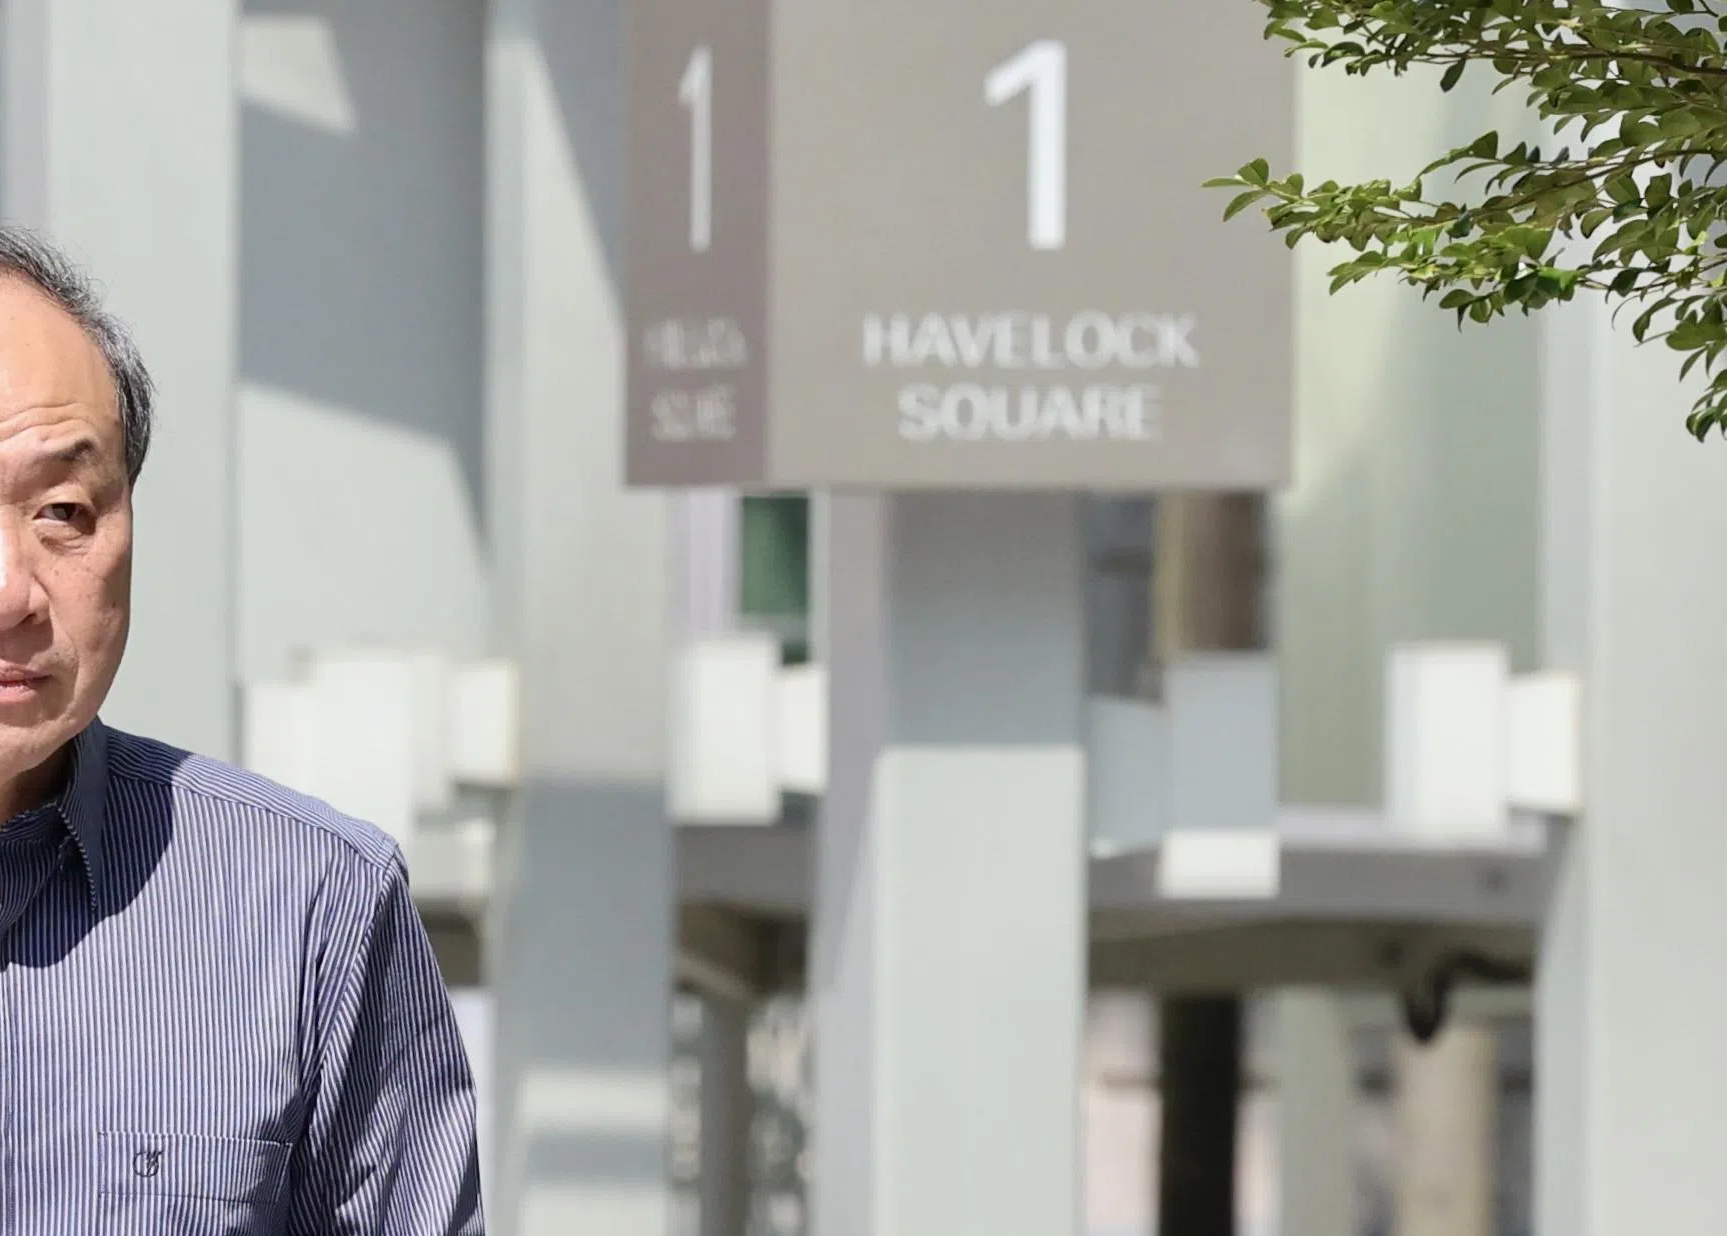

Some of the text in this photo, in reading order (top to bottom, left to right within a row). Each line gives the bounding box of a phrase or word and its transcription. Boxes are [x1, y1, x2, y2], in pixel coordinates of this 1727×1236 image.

[984, 40, 1066, 250] 1
[862, 311, 1200, 368] HAVELOCK
[896, 383, 1164, 441] SQUARE
